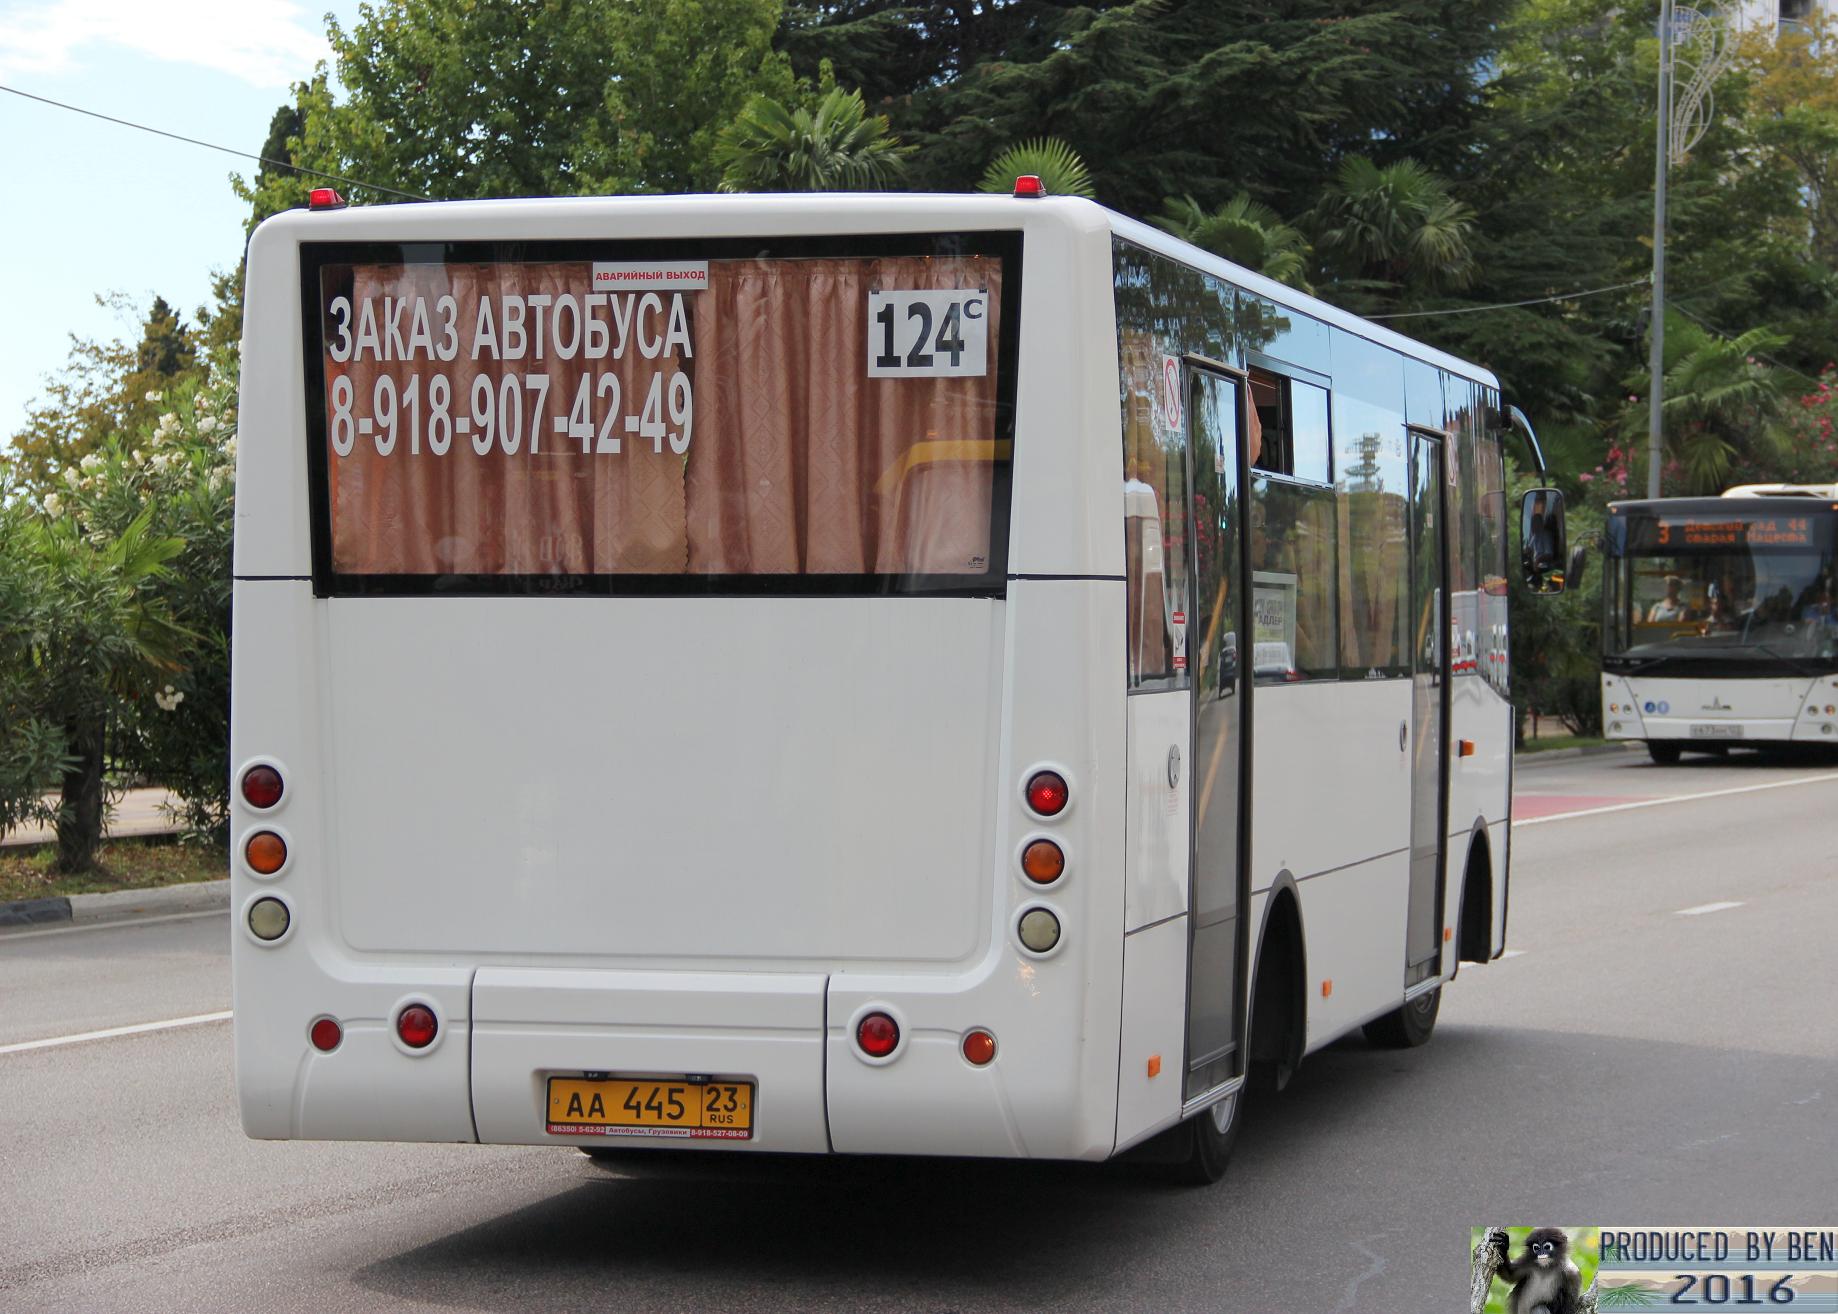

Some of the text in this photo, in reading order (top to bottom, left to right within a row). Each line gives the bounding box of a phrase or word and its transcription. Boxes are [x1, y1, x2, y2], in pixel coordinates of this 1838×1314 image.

[596, 270, 706, 280] АВАРИЙНЫЙ ВЫХОД
[329, 292, 693, 363] ЗАКАЗ АВТОБУСА
[331, 371, 693, 457] 8-918-907-42-49
[623, 1086, 685, 1120] 445
[706, 1086, 738, 1113] 23
[709, 1114, 734, 1124] RUS
